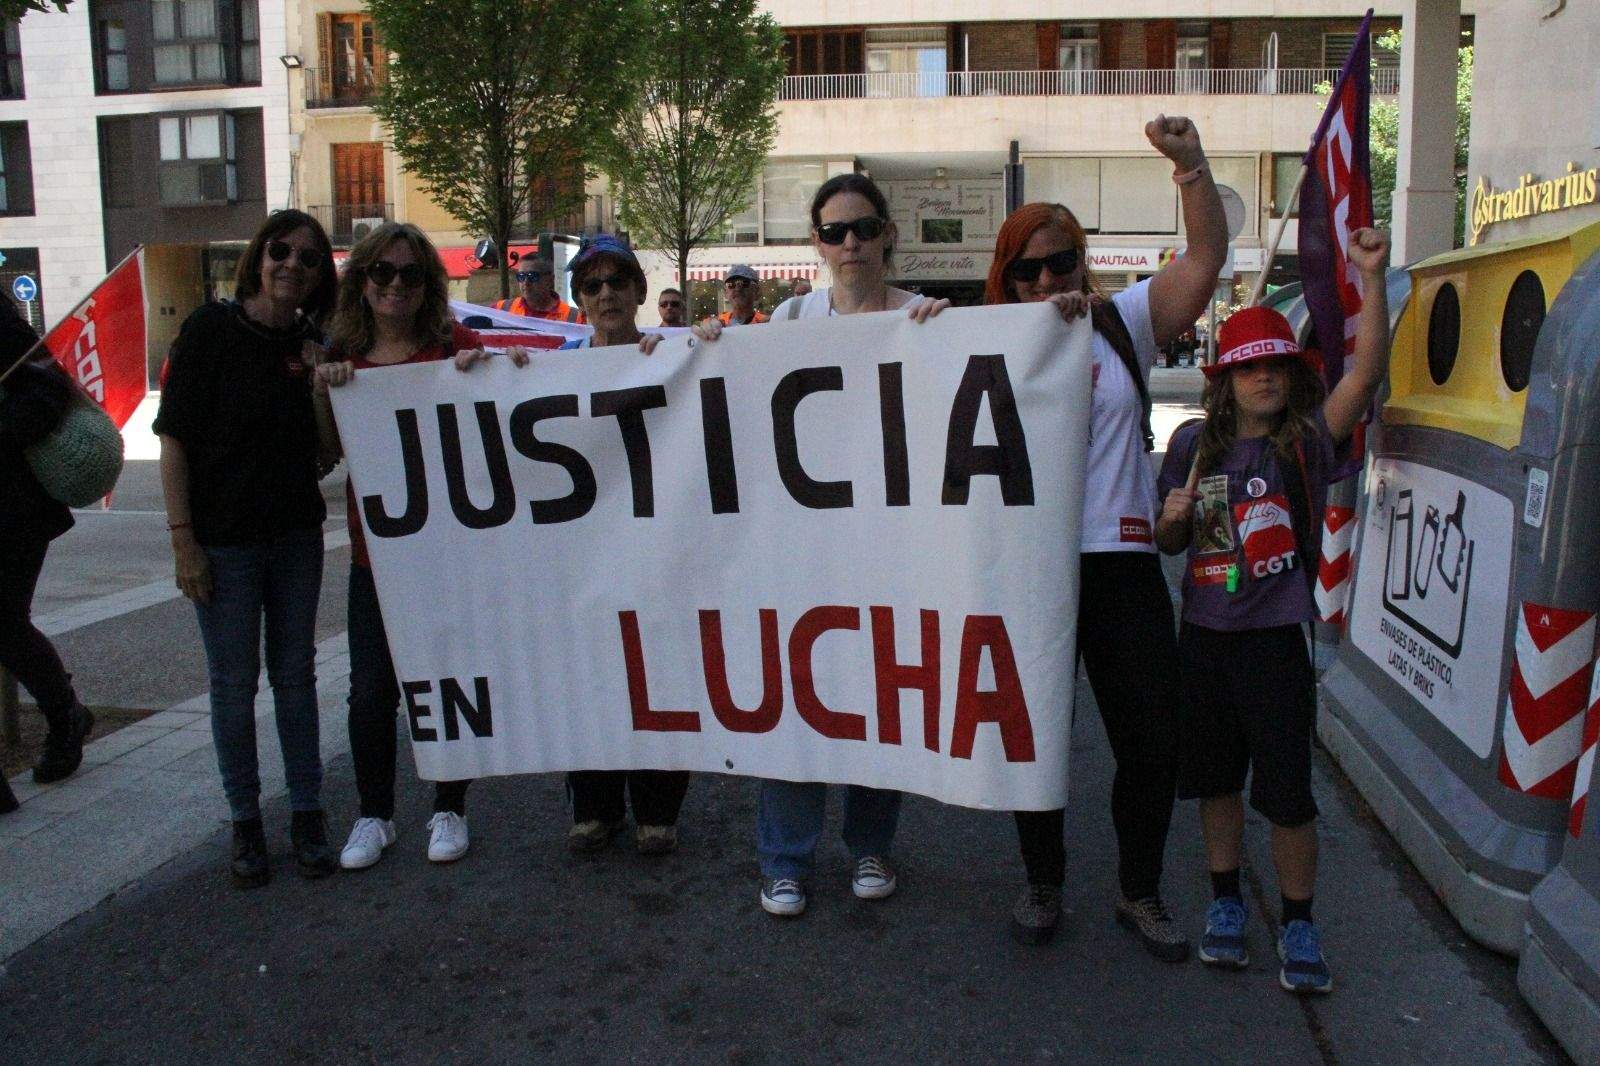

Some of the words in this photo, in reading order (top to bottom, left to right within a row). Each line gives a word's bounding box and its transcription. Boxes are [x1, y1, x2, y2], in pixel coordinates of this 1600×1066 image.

[901, 255, 945, 273] Dolce
[950, 256, 975, 270] vita
[1088, 255, 1148, 266] NAUTALIA
[361, 353, 1035, 538] JUSTICIA
[1253, 550, 1295, 578] CGT
[1380, 617, 1408, 650] ENVASES
[1408, 638, 1418, 658] DE
[401, 676, 494, 742] EN
[617, 604, 1036, 763] LUCHA
[1388, 648, 1408, 677] LATAS
[1408, 664, 1414, 681] Y
[1413, 669, 1435, 699] BRIKS
